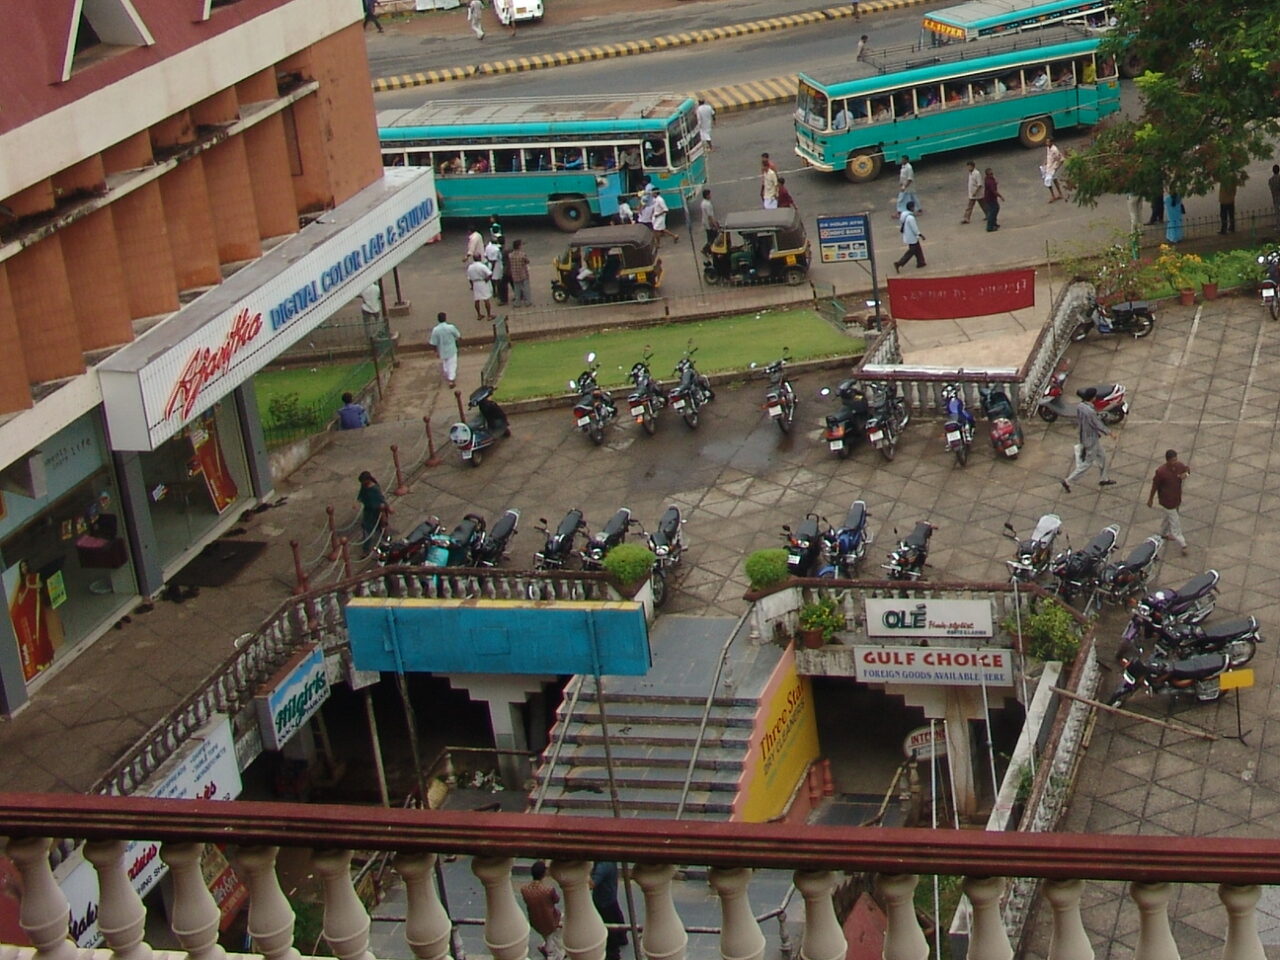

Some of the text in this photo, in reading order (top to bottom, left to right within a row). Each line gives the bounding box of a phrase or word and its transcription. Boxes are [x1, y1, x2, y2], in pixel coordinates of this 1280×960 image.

[269, 197, 434, 331] DIGITAL COLOR LAB & STUDIO
[882, 603, 927, 629] OLÉ
[863, 651, 1003, 667] GULF CHOICE
[863, 669, 901, 679] FOREIGN
[902, 670, 932, 680] GOODS
[933, 671, 981, 681] AVAILABLE
[759, 709, 788, 760] Three
